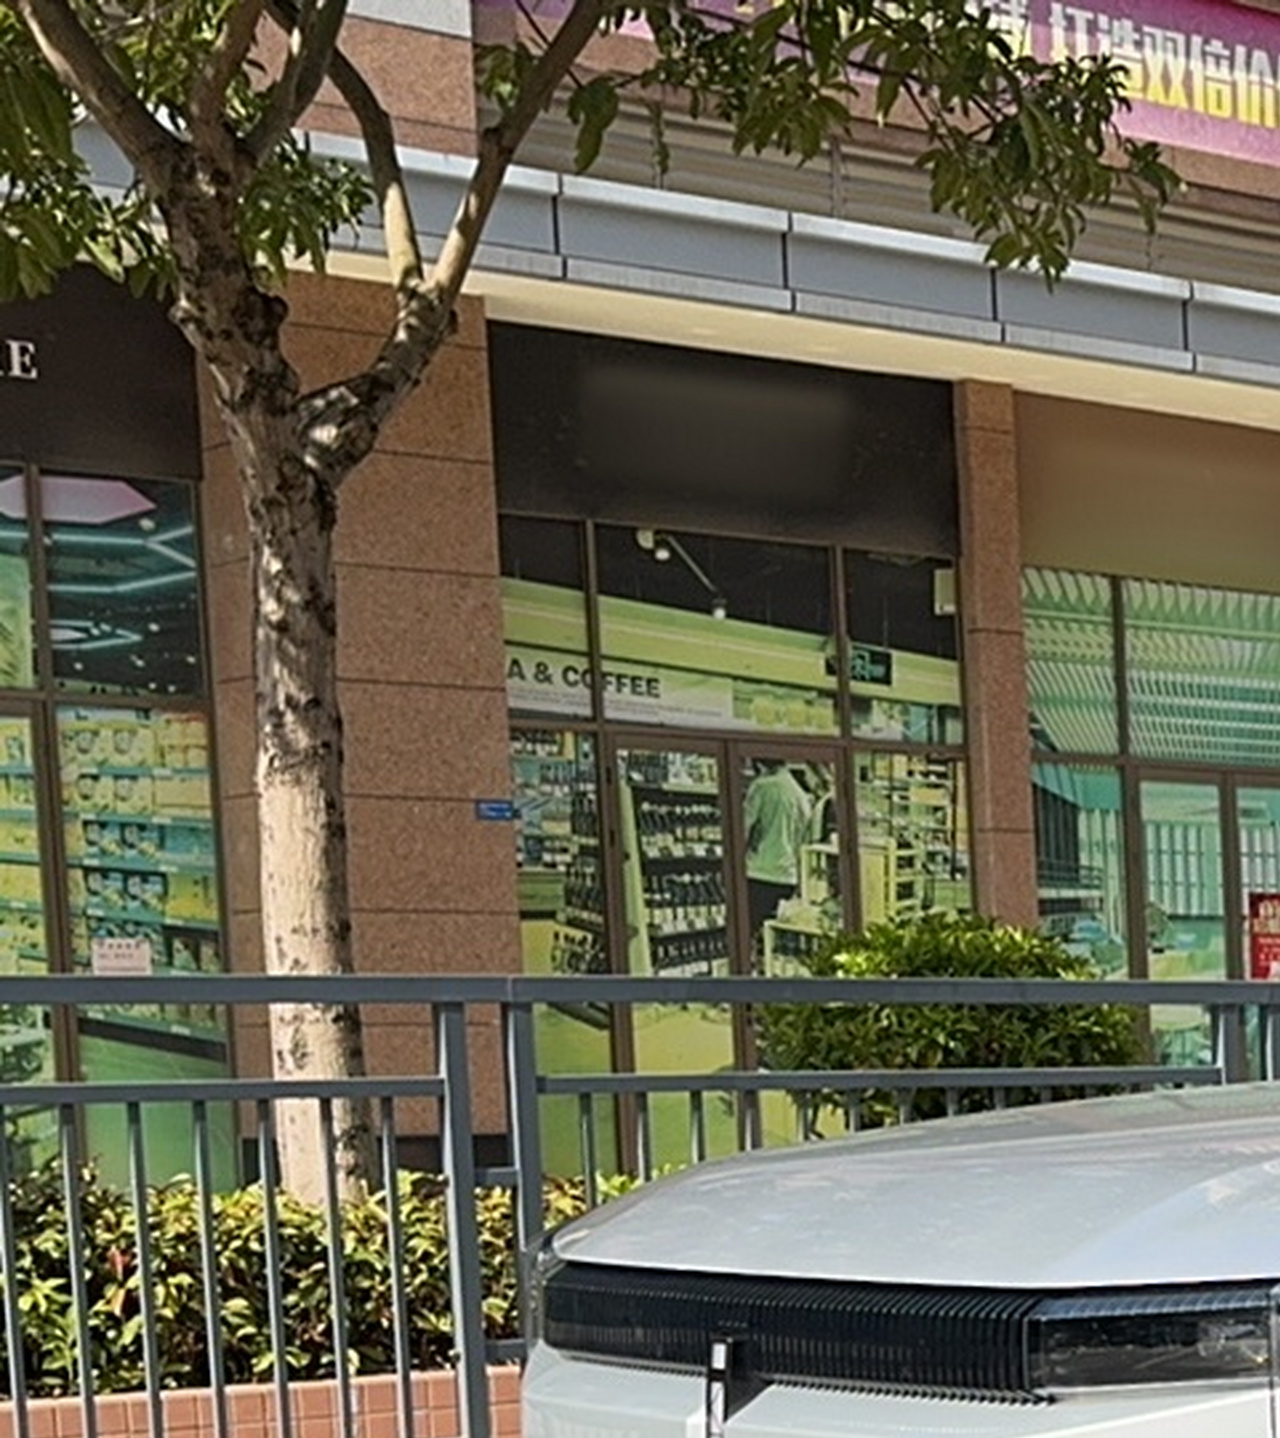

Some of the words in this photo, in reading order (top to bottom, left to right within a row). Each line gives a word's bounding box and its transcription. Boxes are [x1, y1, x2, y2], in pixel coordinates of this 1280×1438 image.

[0, 339, 38, 379] E
[533, 661, 553, 685] &
[562, 665, 661, 699] COFFEE
